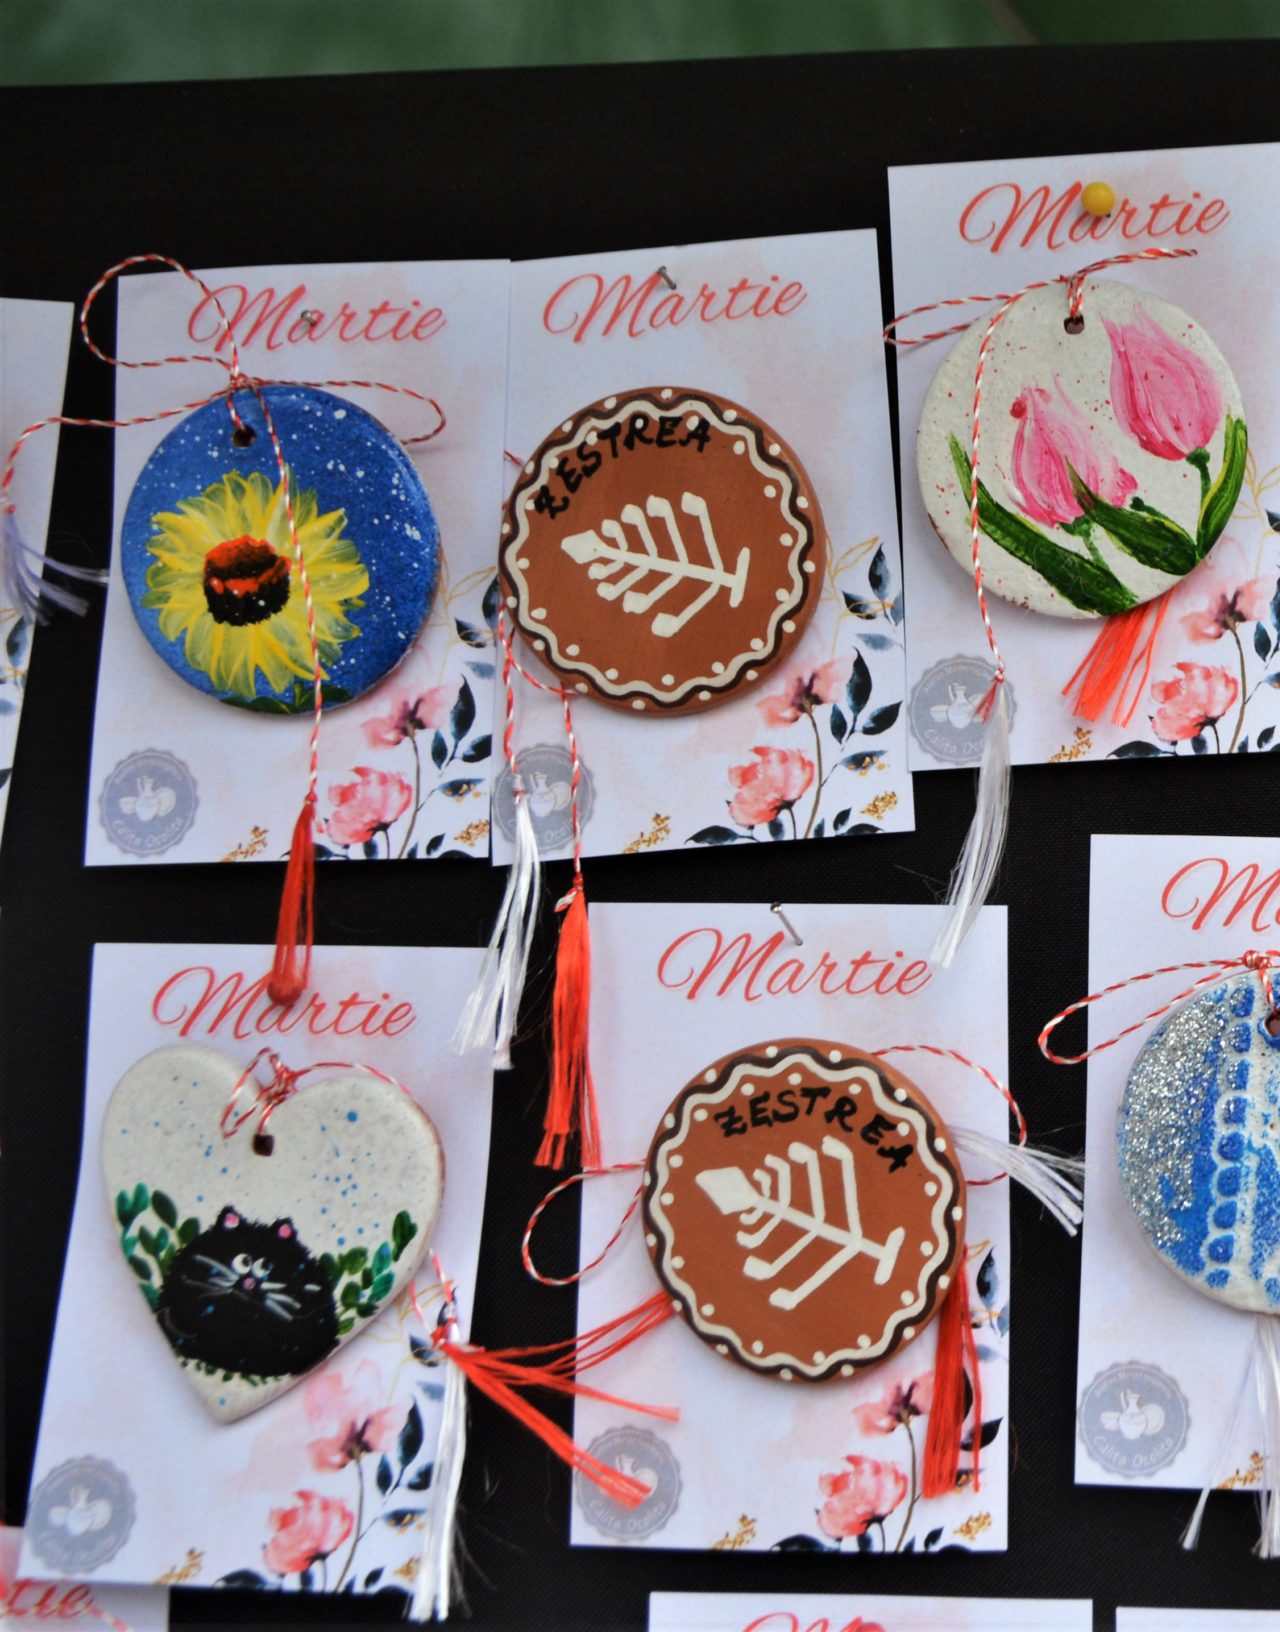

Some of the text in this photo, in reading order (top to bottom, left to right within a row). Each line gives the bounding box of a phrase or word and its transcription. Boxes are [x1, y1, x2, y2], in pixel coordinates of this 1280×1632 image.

[959, 181, 1230, 253] Martie
[187, 284, 447, 352] Martie
[543, 272, 807, 344] Martie
[534, 413, 711, 520] ZESTREA
[657, 927, 932, 1002] Martie
[152, 966, 416, 1040] Martie
[713, 1086, 914, 1174] ZESTREA
